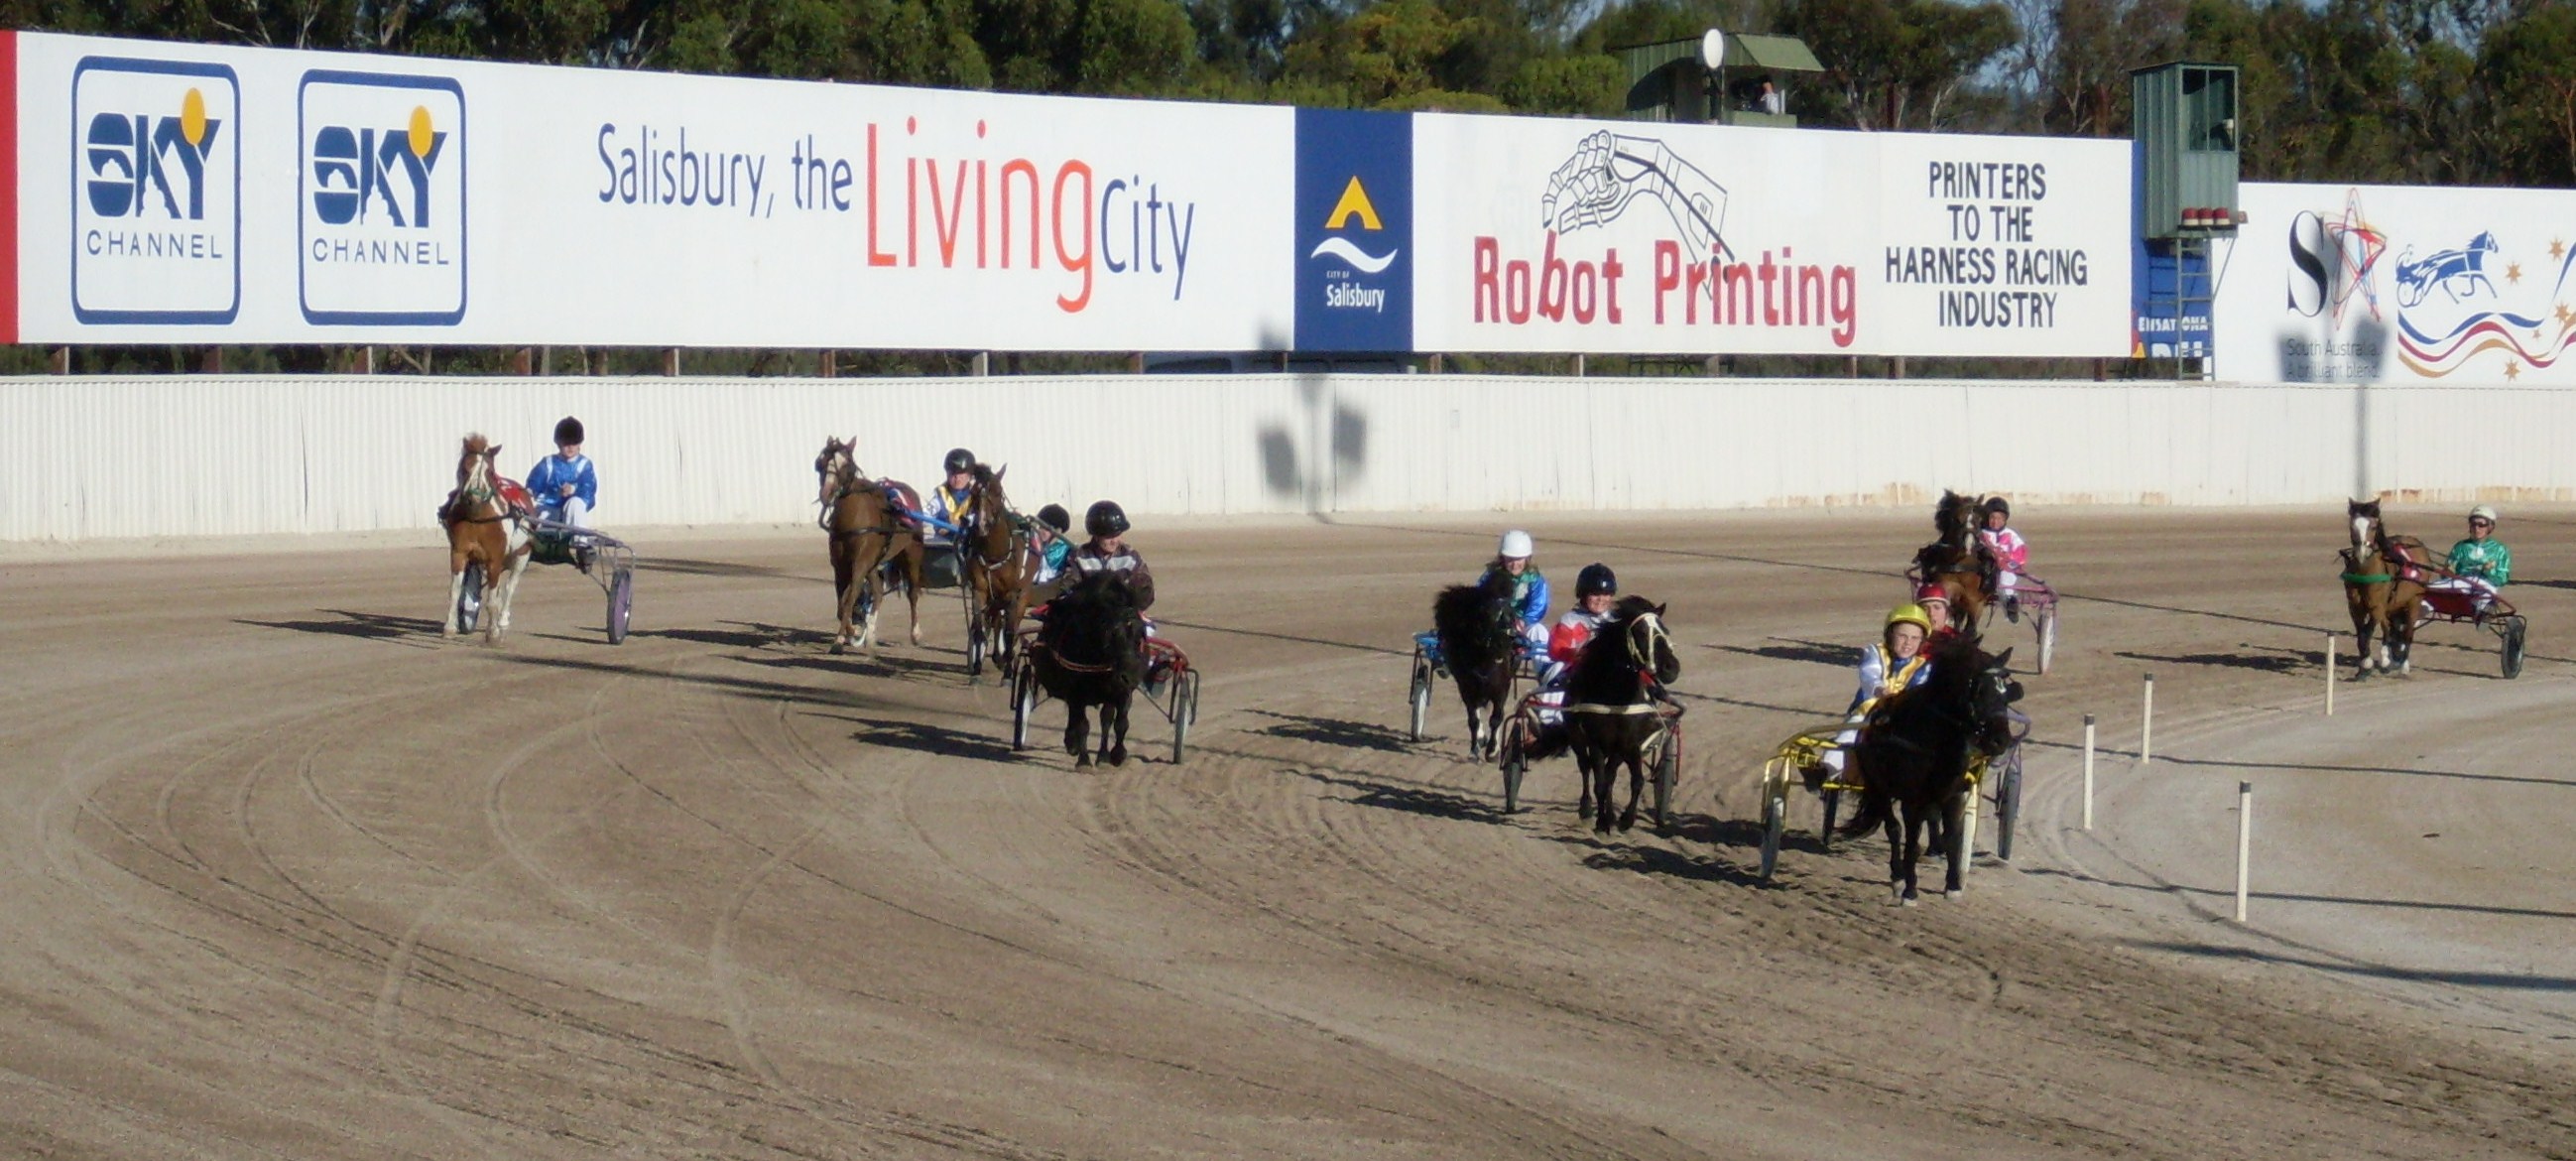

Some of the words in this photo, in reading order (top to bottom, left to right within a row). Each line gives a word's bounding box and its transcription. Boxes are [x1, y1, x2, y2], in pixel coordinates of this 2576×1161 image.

[87, 111, 221, 220] SKY
[313, 126, 447, 228] SKY
[1929, 161, 2046, 200] PRINTERS
[598, 122, 775, 218] Salisbury,
[791, 134, 853, 212] the
[867, 116, 1092, 314] Living
[1946, 204, 1981, 241] TO
[1990, 205, 2033, 242] THE
[86, 229, 222, 259] CHANNEL
[312, 237, 448, 266] CHANNEL
[1886, 246, 1996, 284] HARNESS
[2006, 248, 2088, 286] RACING
[1326, 282, 1385, 313] Salisbury
[1474, 229, 1623, 324] Robot
[1655, 239, 1856, 347] Printing
[1939, 291, 2057, 328] INDUSTRY
